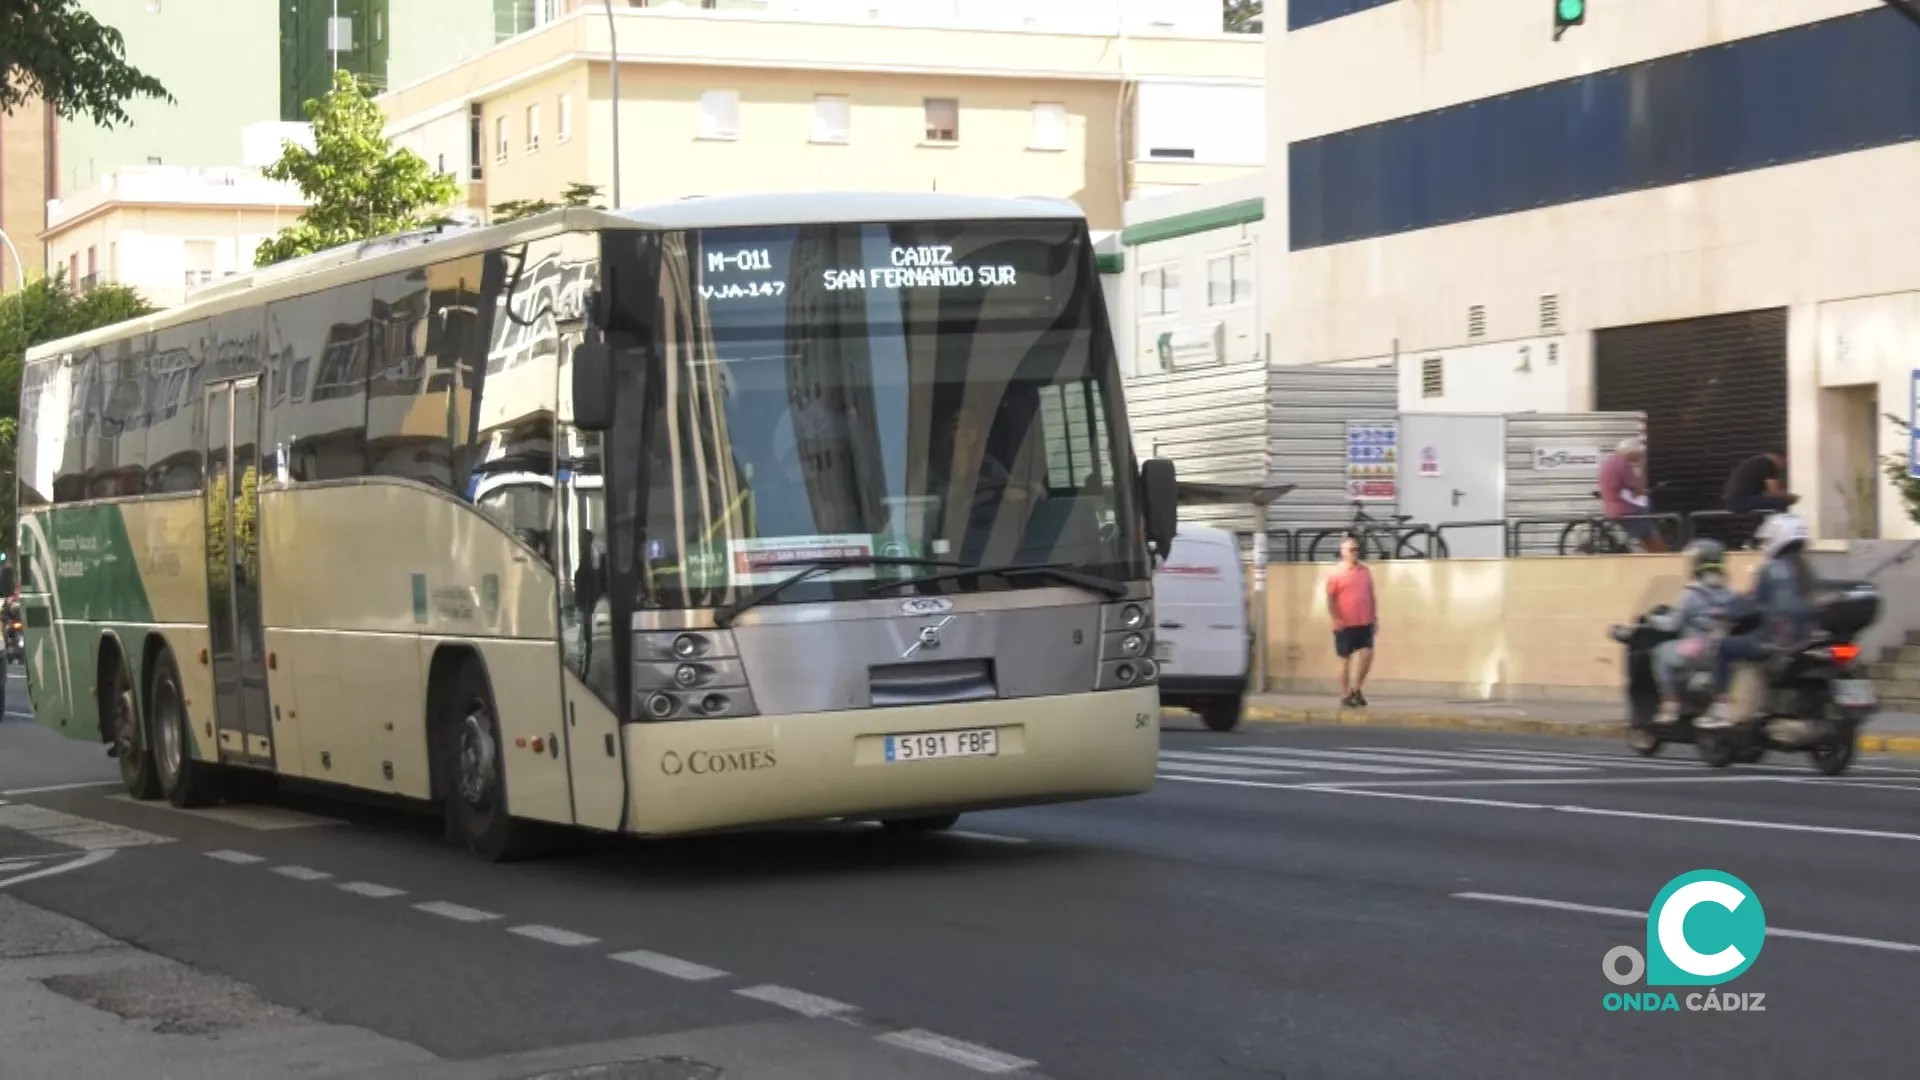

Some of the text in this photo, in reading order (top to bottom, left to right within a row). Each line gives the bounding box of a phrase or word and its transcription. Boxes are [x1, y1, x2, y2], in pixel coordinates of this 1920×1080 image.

[707, 249, 772, 272] M-011
[891, 246, 953, 266] CADIZ
[823, 265, 1016, 290] SAN FERNANDO SUR
[698, 281, 786, 299] VJA-147
[901, 731, 992, 758] 5191 FBF
